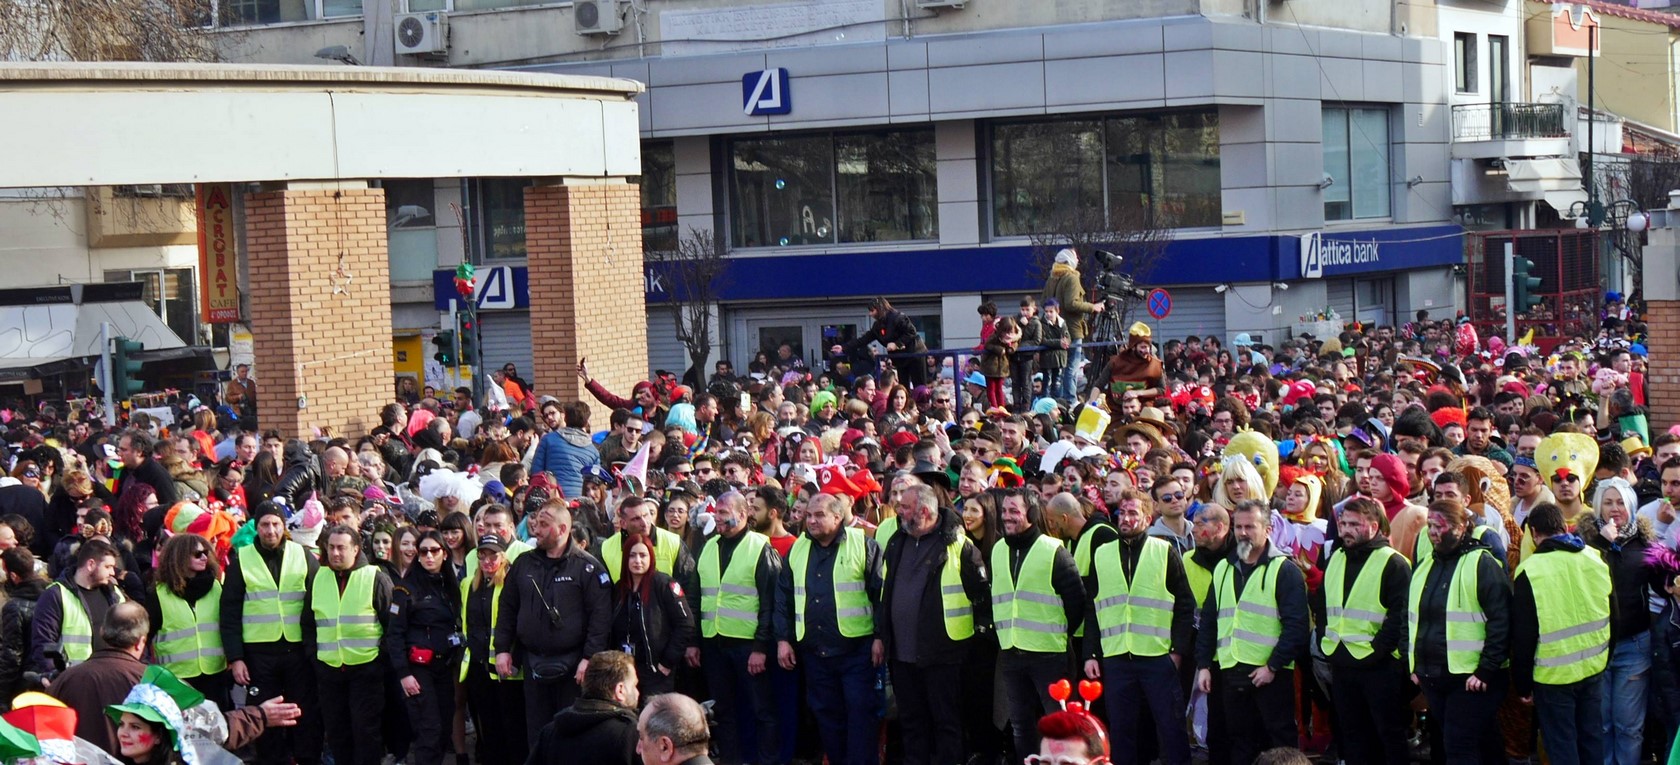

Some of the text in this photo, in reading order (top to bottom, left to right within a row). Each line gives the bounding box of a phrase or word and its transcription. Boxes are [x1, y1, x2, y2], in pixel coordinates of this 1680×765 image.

[206, 185, 230, 298] ACROBAT
[1321, 240, 1352, 266] attica
[1353, 237, 1380, 264] bank
